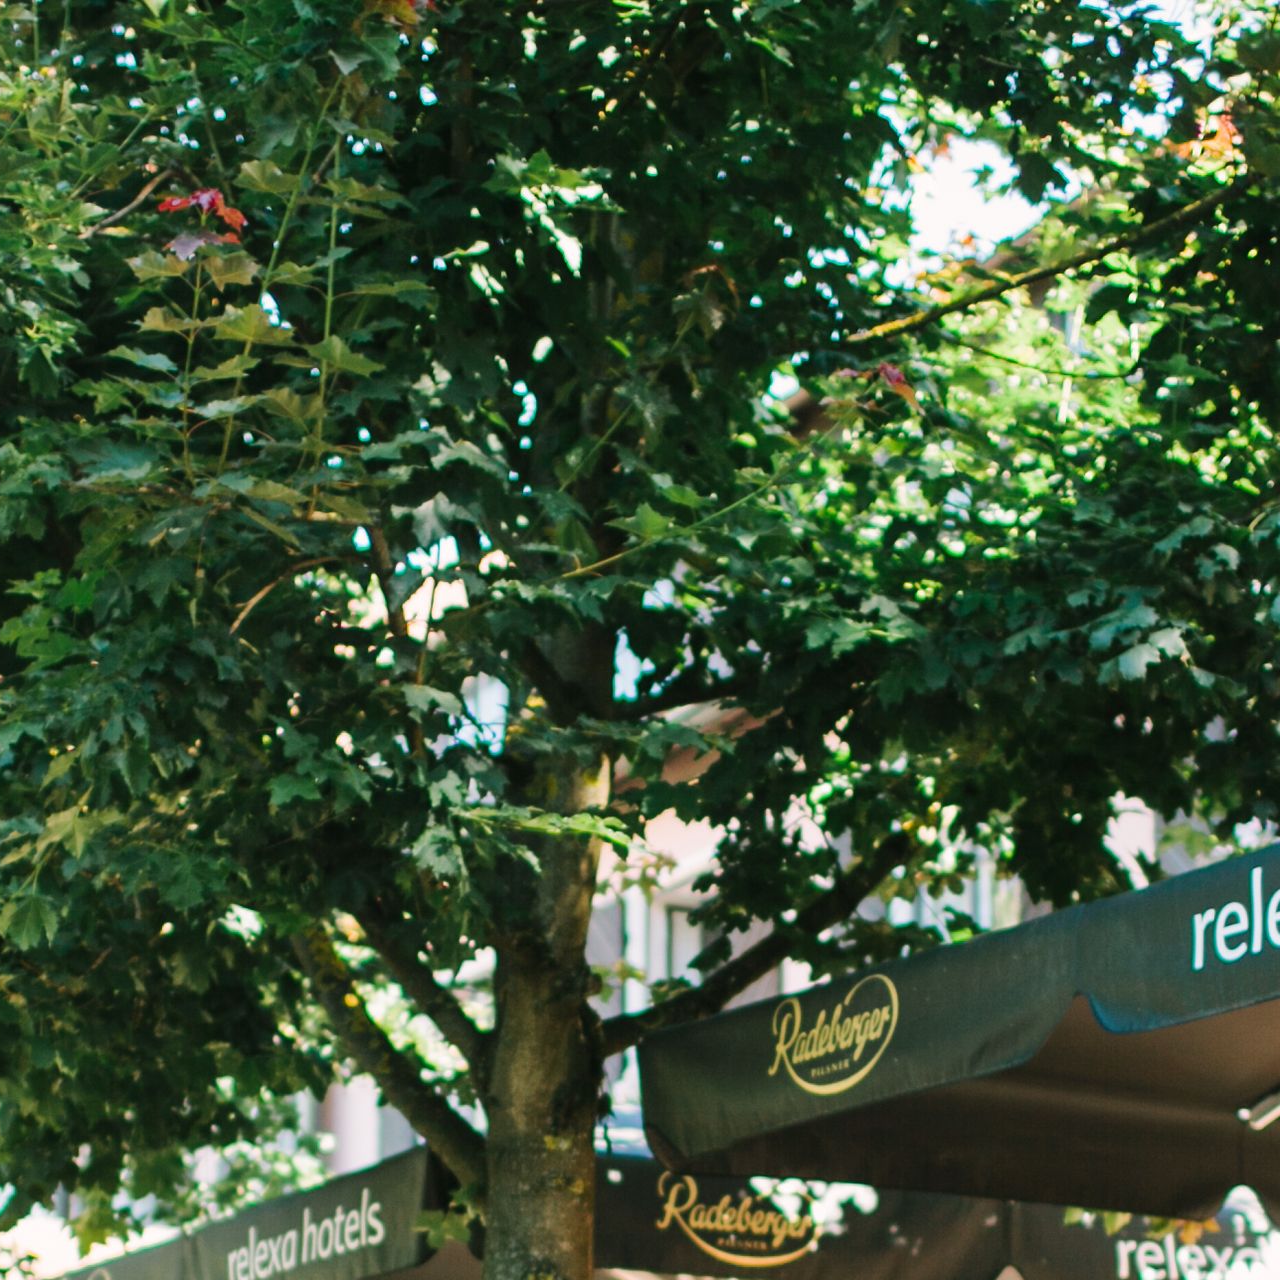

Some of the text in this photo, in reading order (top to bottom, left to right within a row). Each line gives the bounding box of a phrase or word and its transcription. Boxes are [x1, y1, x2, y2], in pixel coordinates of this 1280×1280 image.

[767, 995, 892, 1077] Radeberger
[810, 1058, 850, 1078] PILSNER
[300, 1186, 385, 1265] hotels
[655, 1170, 813, 1249] Radeberger
